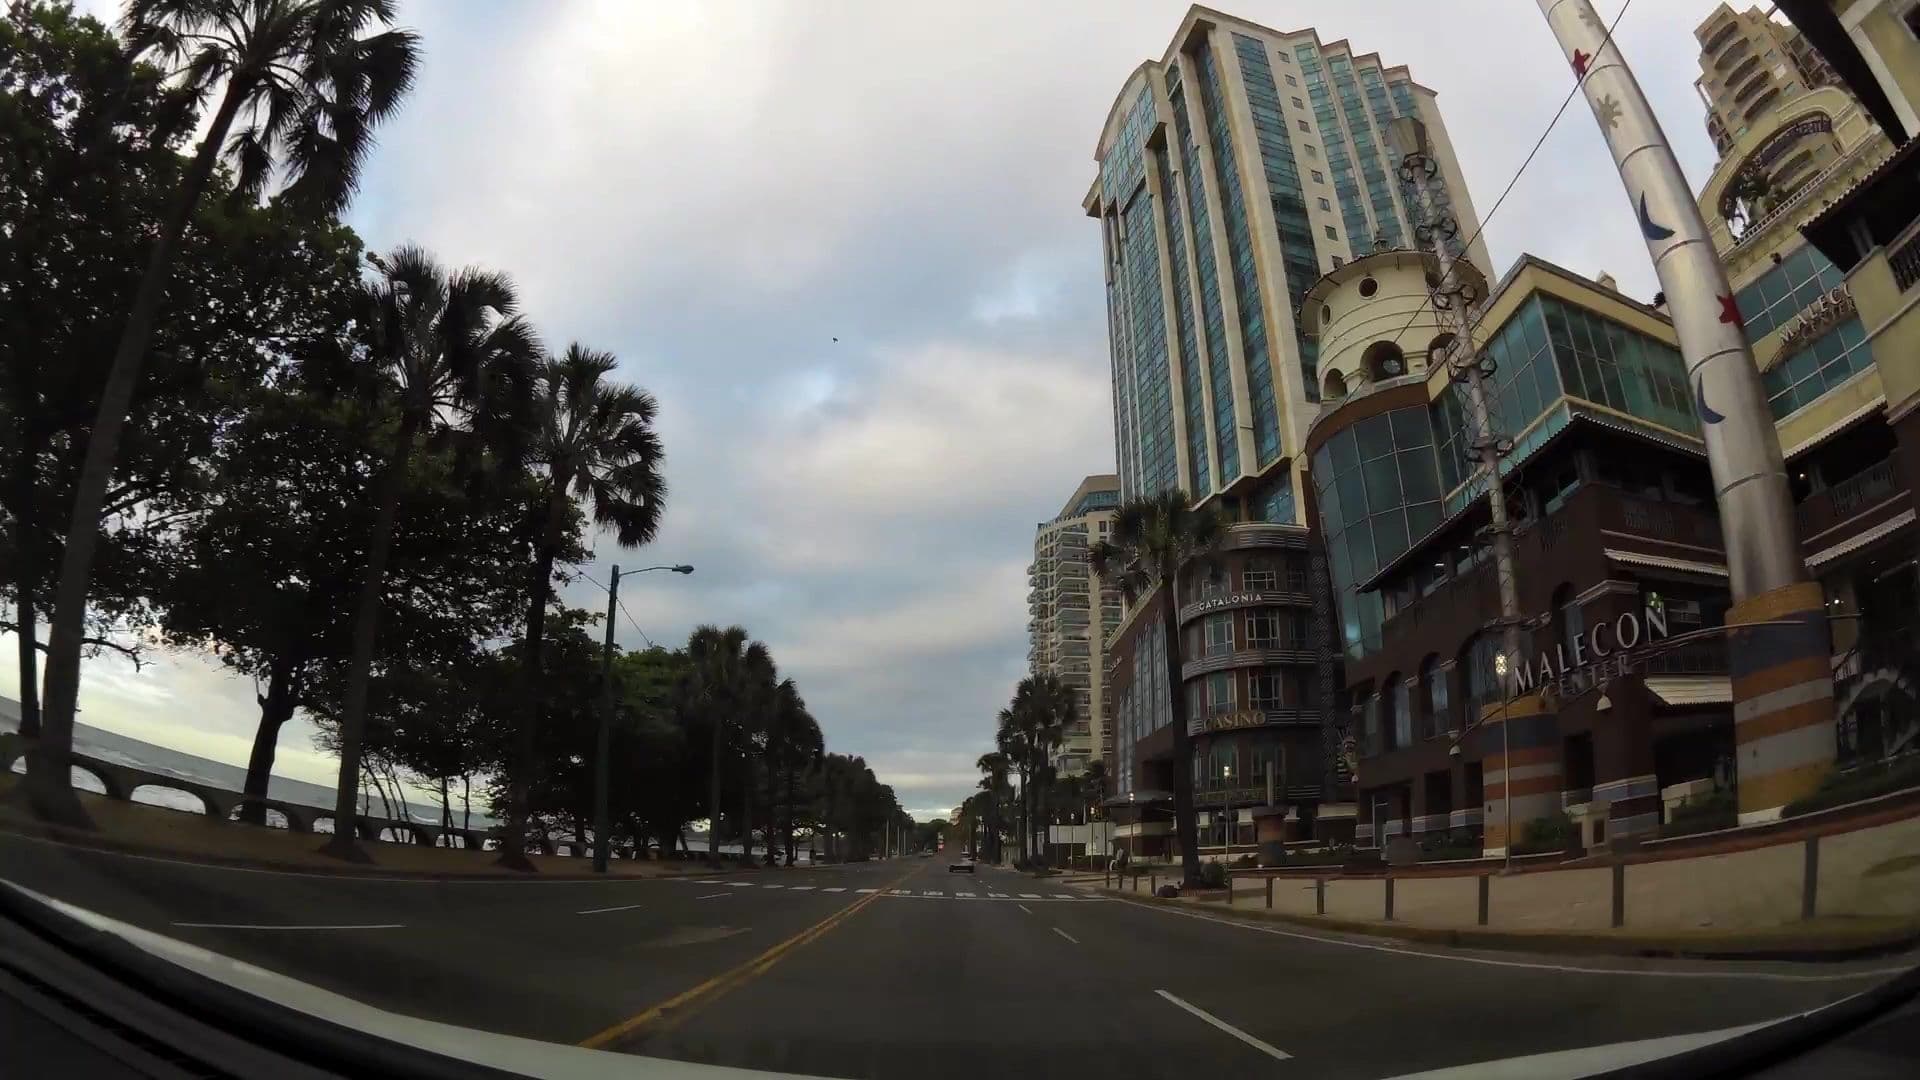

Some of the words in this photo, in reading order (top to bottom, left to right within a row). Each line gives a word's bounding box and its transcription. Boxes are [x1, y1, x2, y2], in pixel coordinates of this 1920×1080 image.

[1199, 593, 1263, 611] CATALONIA
[1514, 604, 1668, 697] MALECON
[1203, 711, 1267, 730] CASINO
